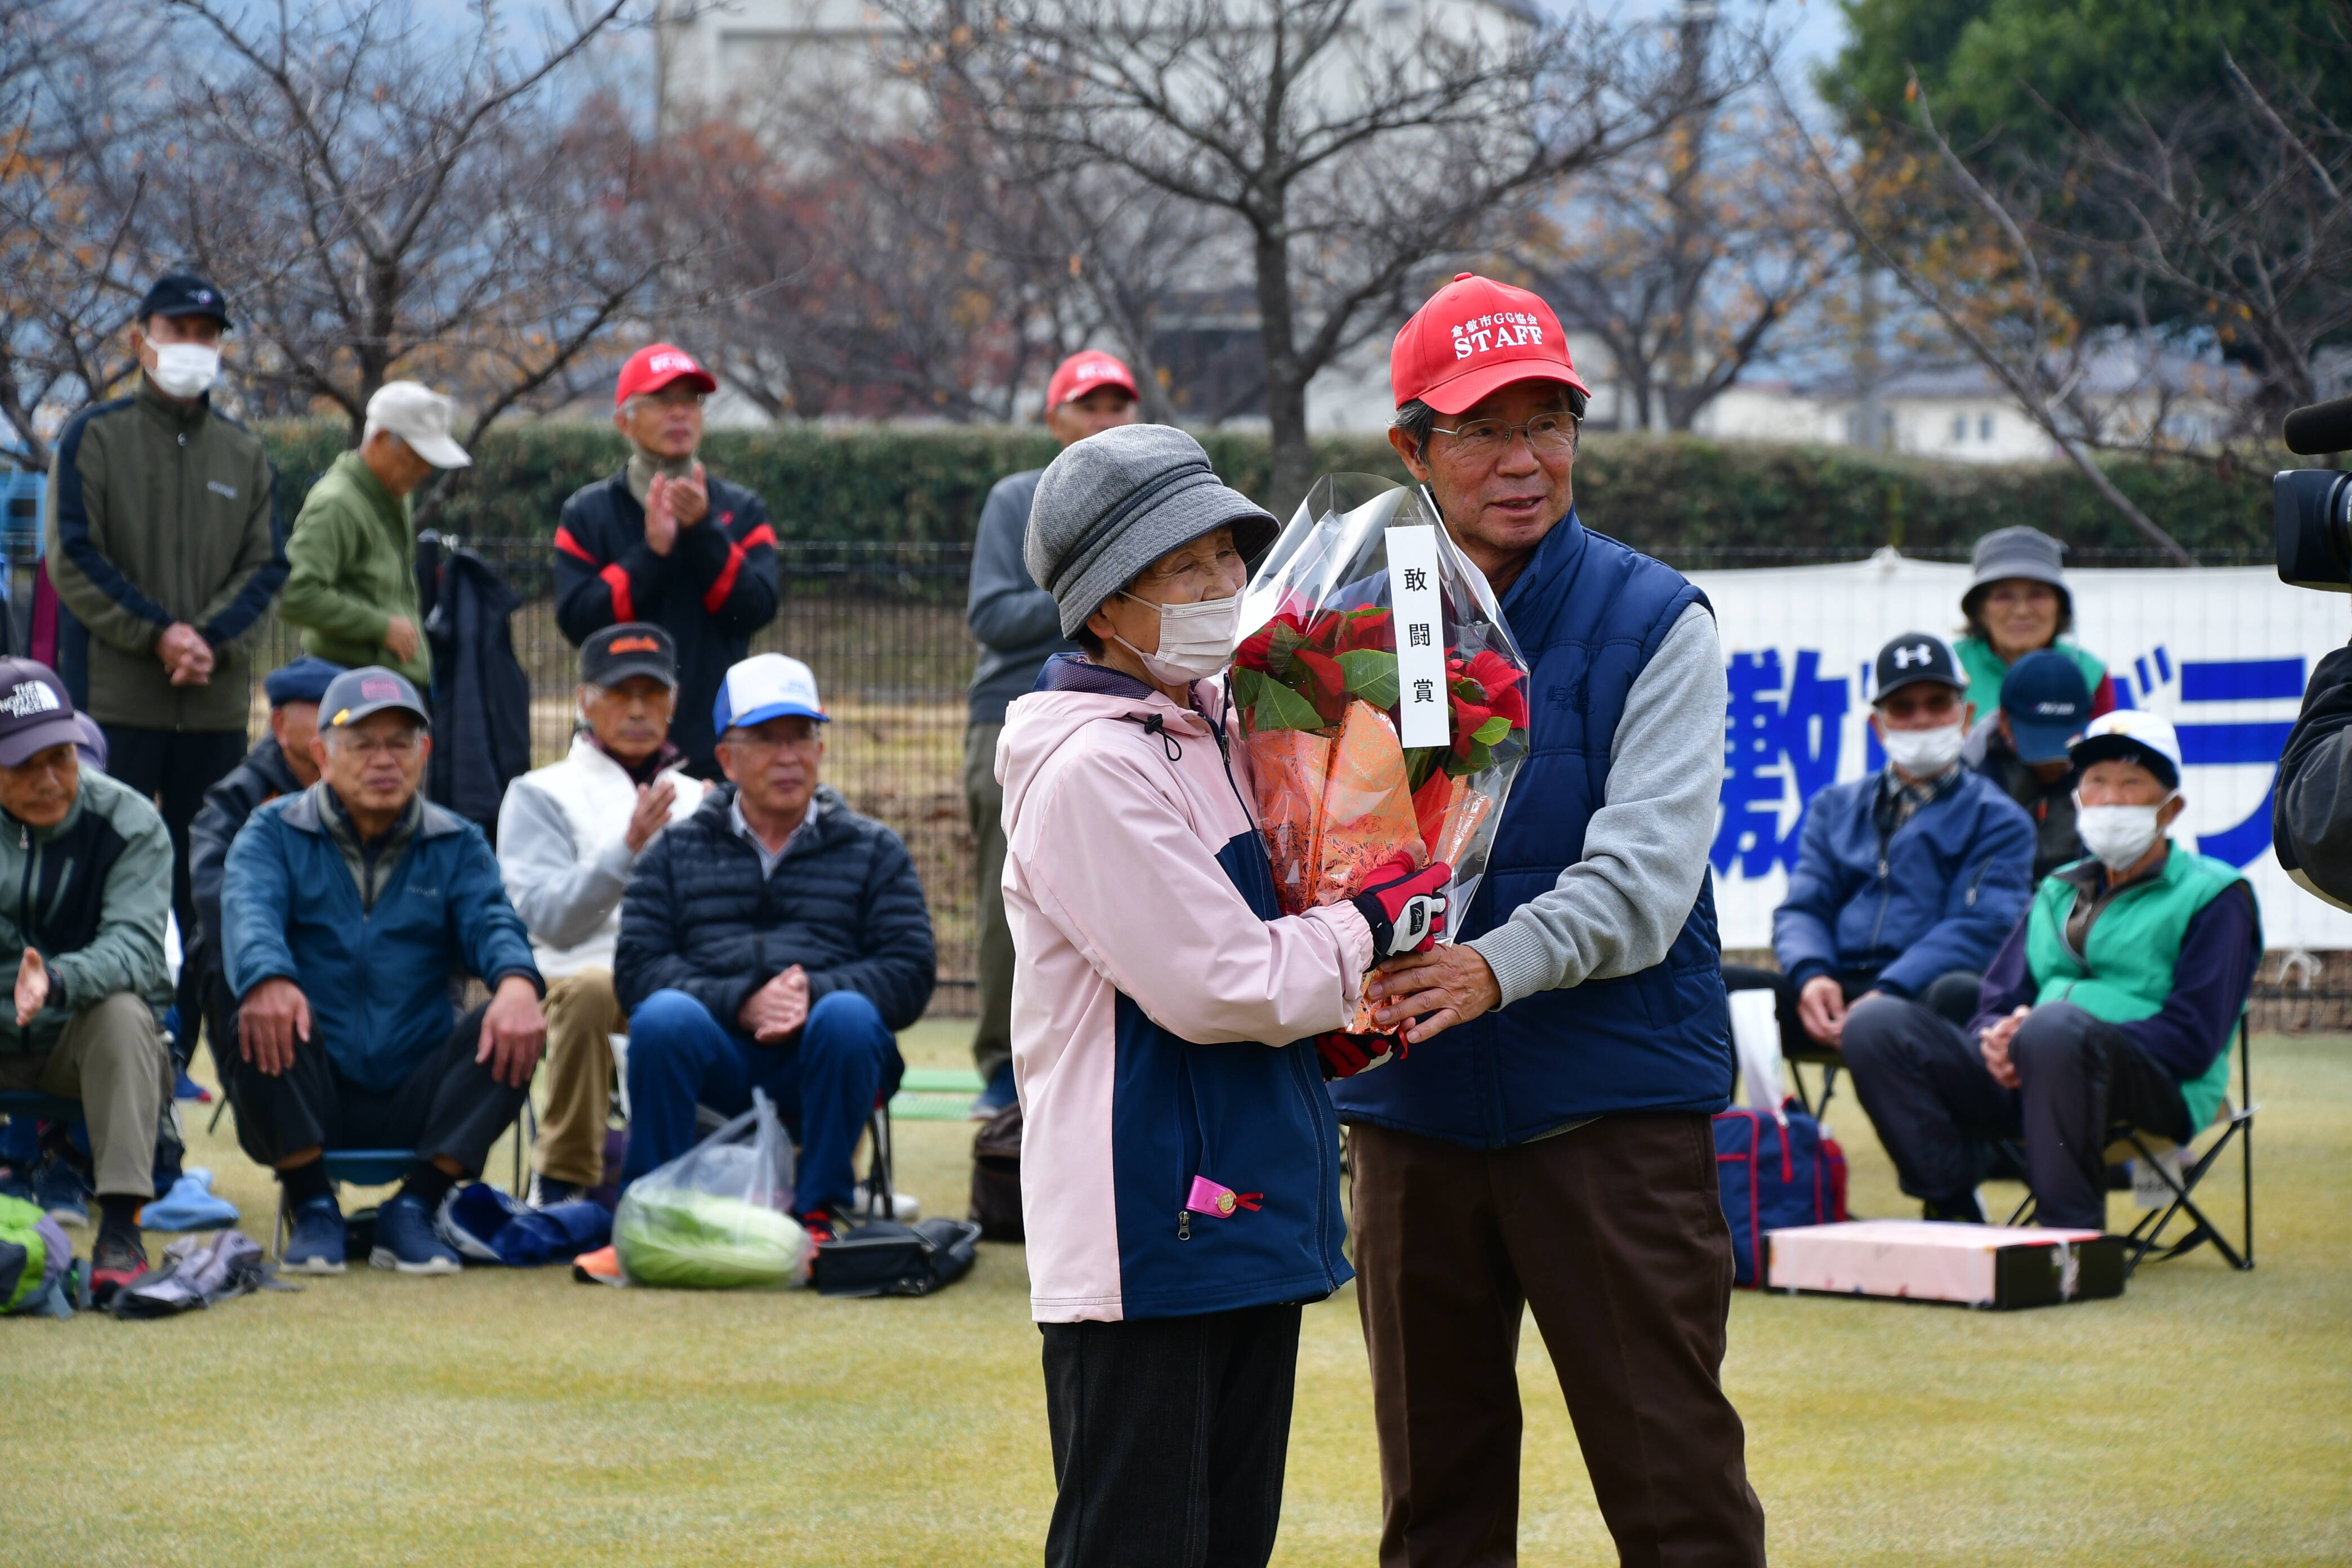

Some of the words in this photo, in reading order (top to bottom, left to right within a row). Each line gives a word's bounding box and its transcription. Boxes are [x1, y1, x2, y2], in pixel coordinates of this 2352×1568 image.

[1451, 312, 1538, 338] 倉敷市GG協会
[1454, 325, 1543, 360] STAFF
[1404, 567, 1435, 704] 敢闘賞
